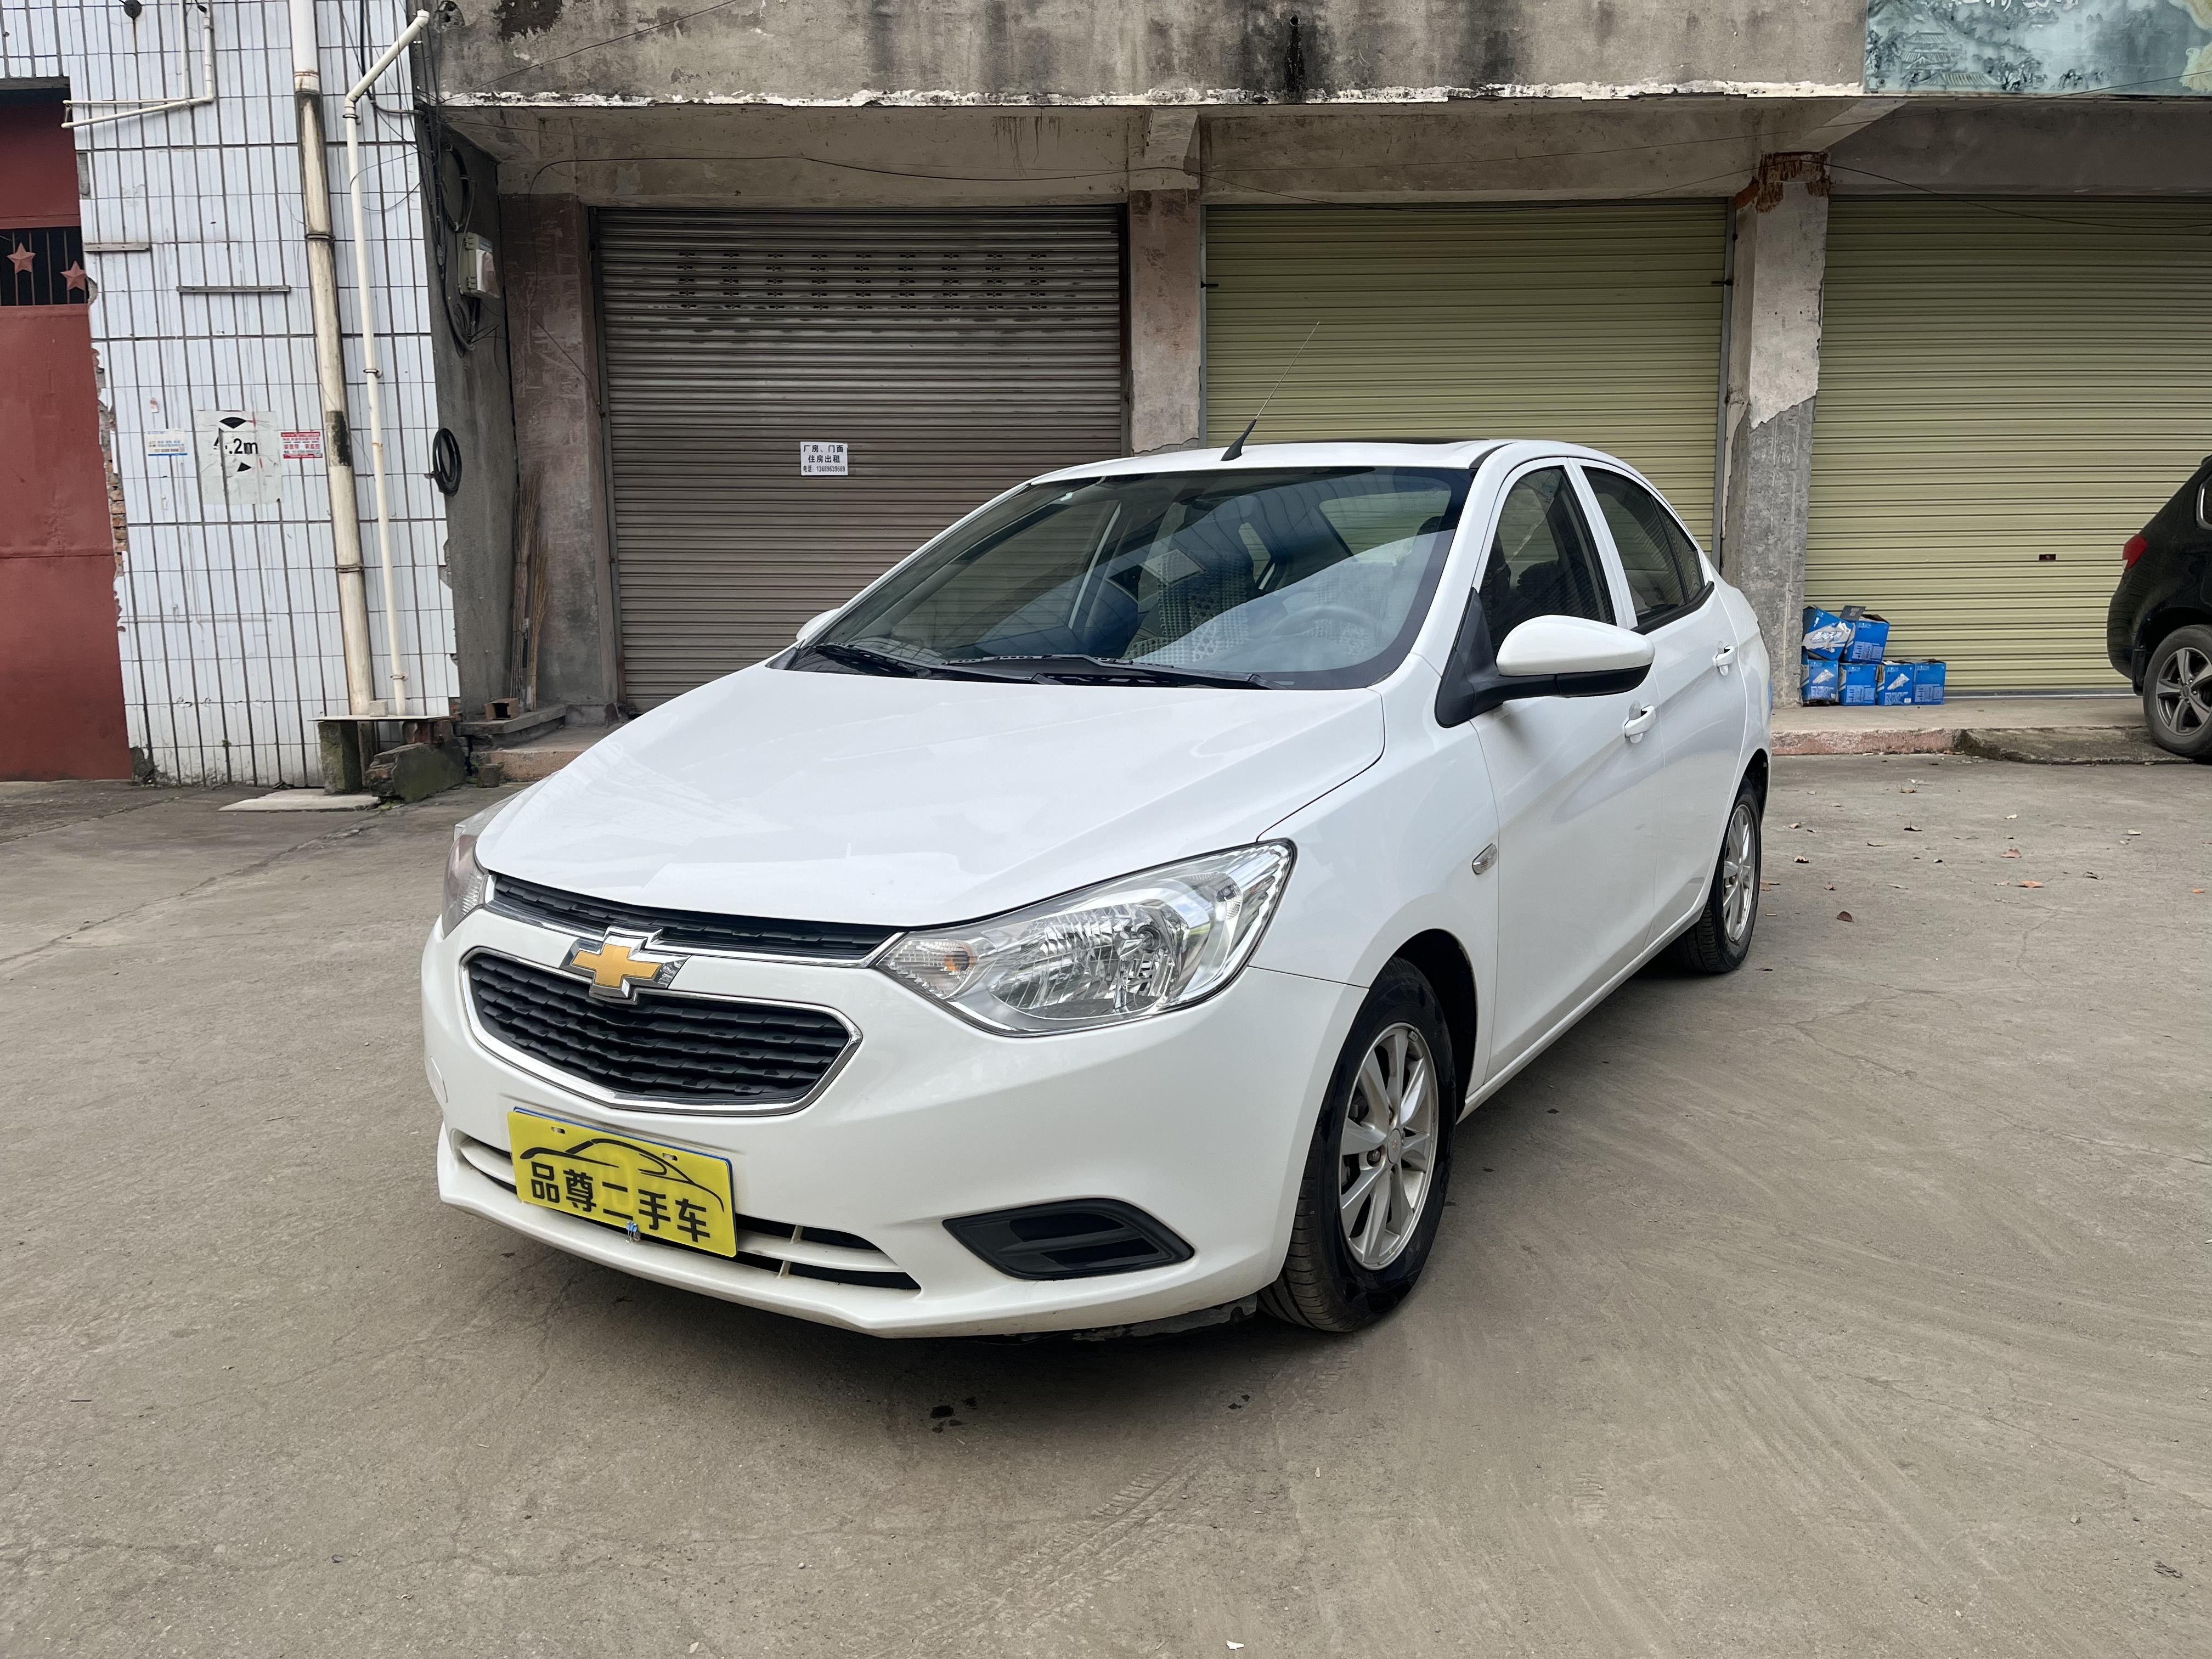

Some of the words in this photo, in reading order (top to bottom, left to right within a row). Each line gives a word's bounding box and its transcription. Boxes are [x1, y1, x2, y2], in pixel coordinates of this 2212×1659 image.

[808, 455, 840, 463] 住房出租
[531, 1161, 711, 1243] 品尊二手车
